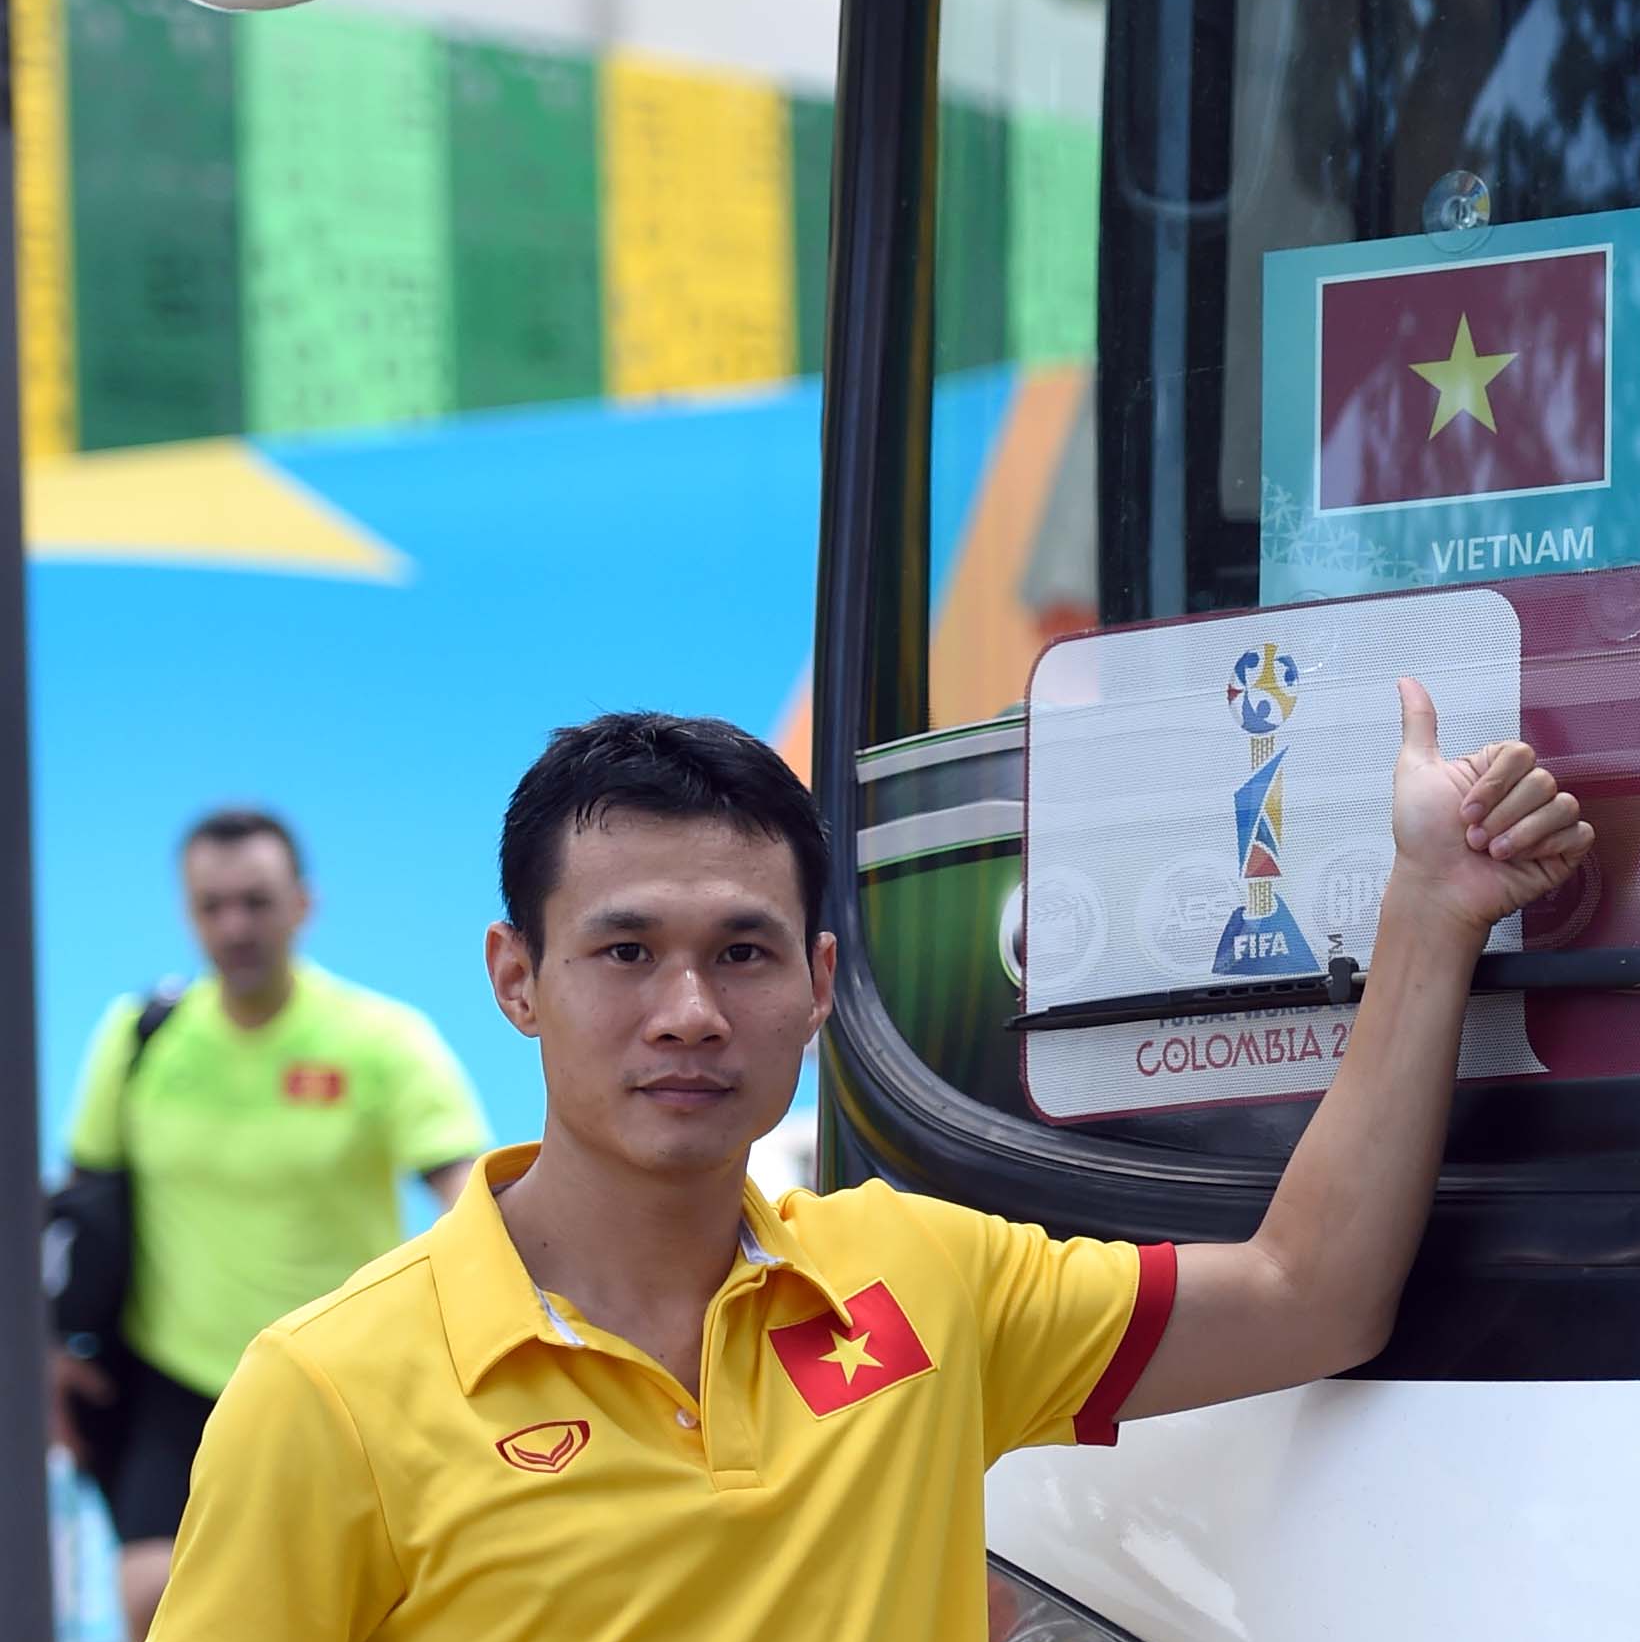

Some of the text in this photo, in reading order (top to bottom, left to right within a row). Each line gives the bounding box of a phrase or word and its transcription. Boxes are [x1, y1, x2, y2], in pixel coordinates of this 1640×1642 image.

[1431, 525, 1594, 574] VIETNAM
[1232, 931, 1290, 961] FIFA
[1136, 1024, 1323, 1077] COLOMBIA
